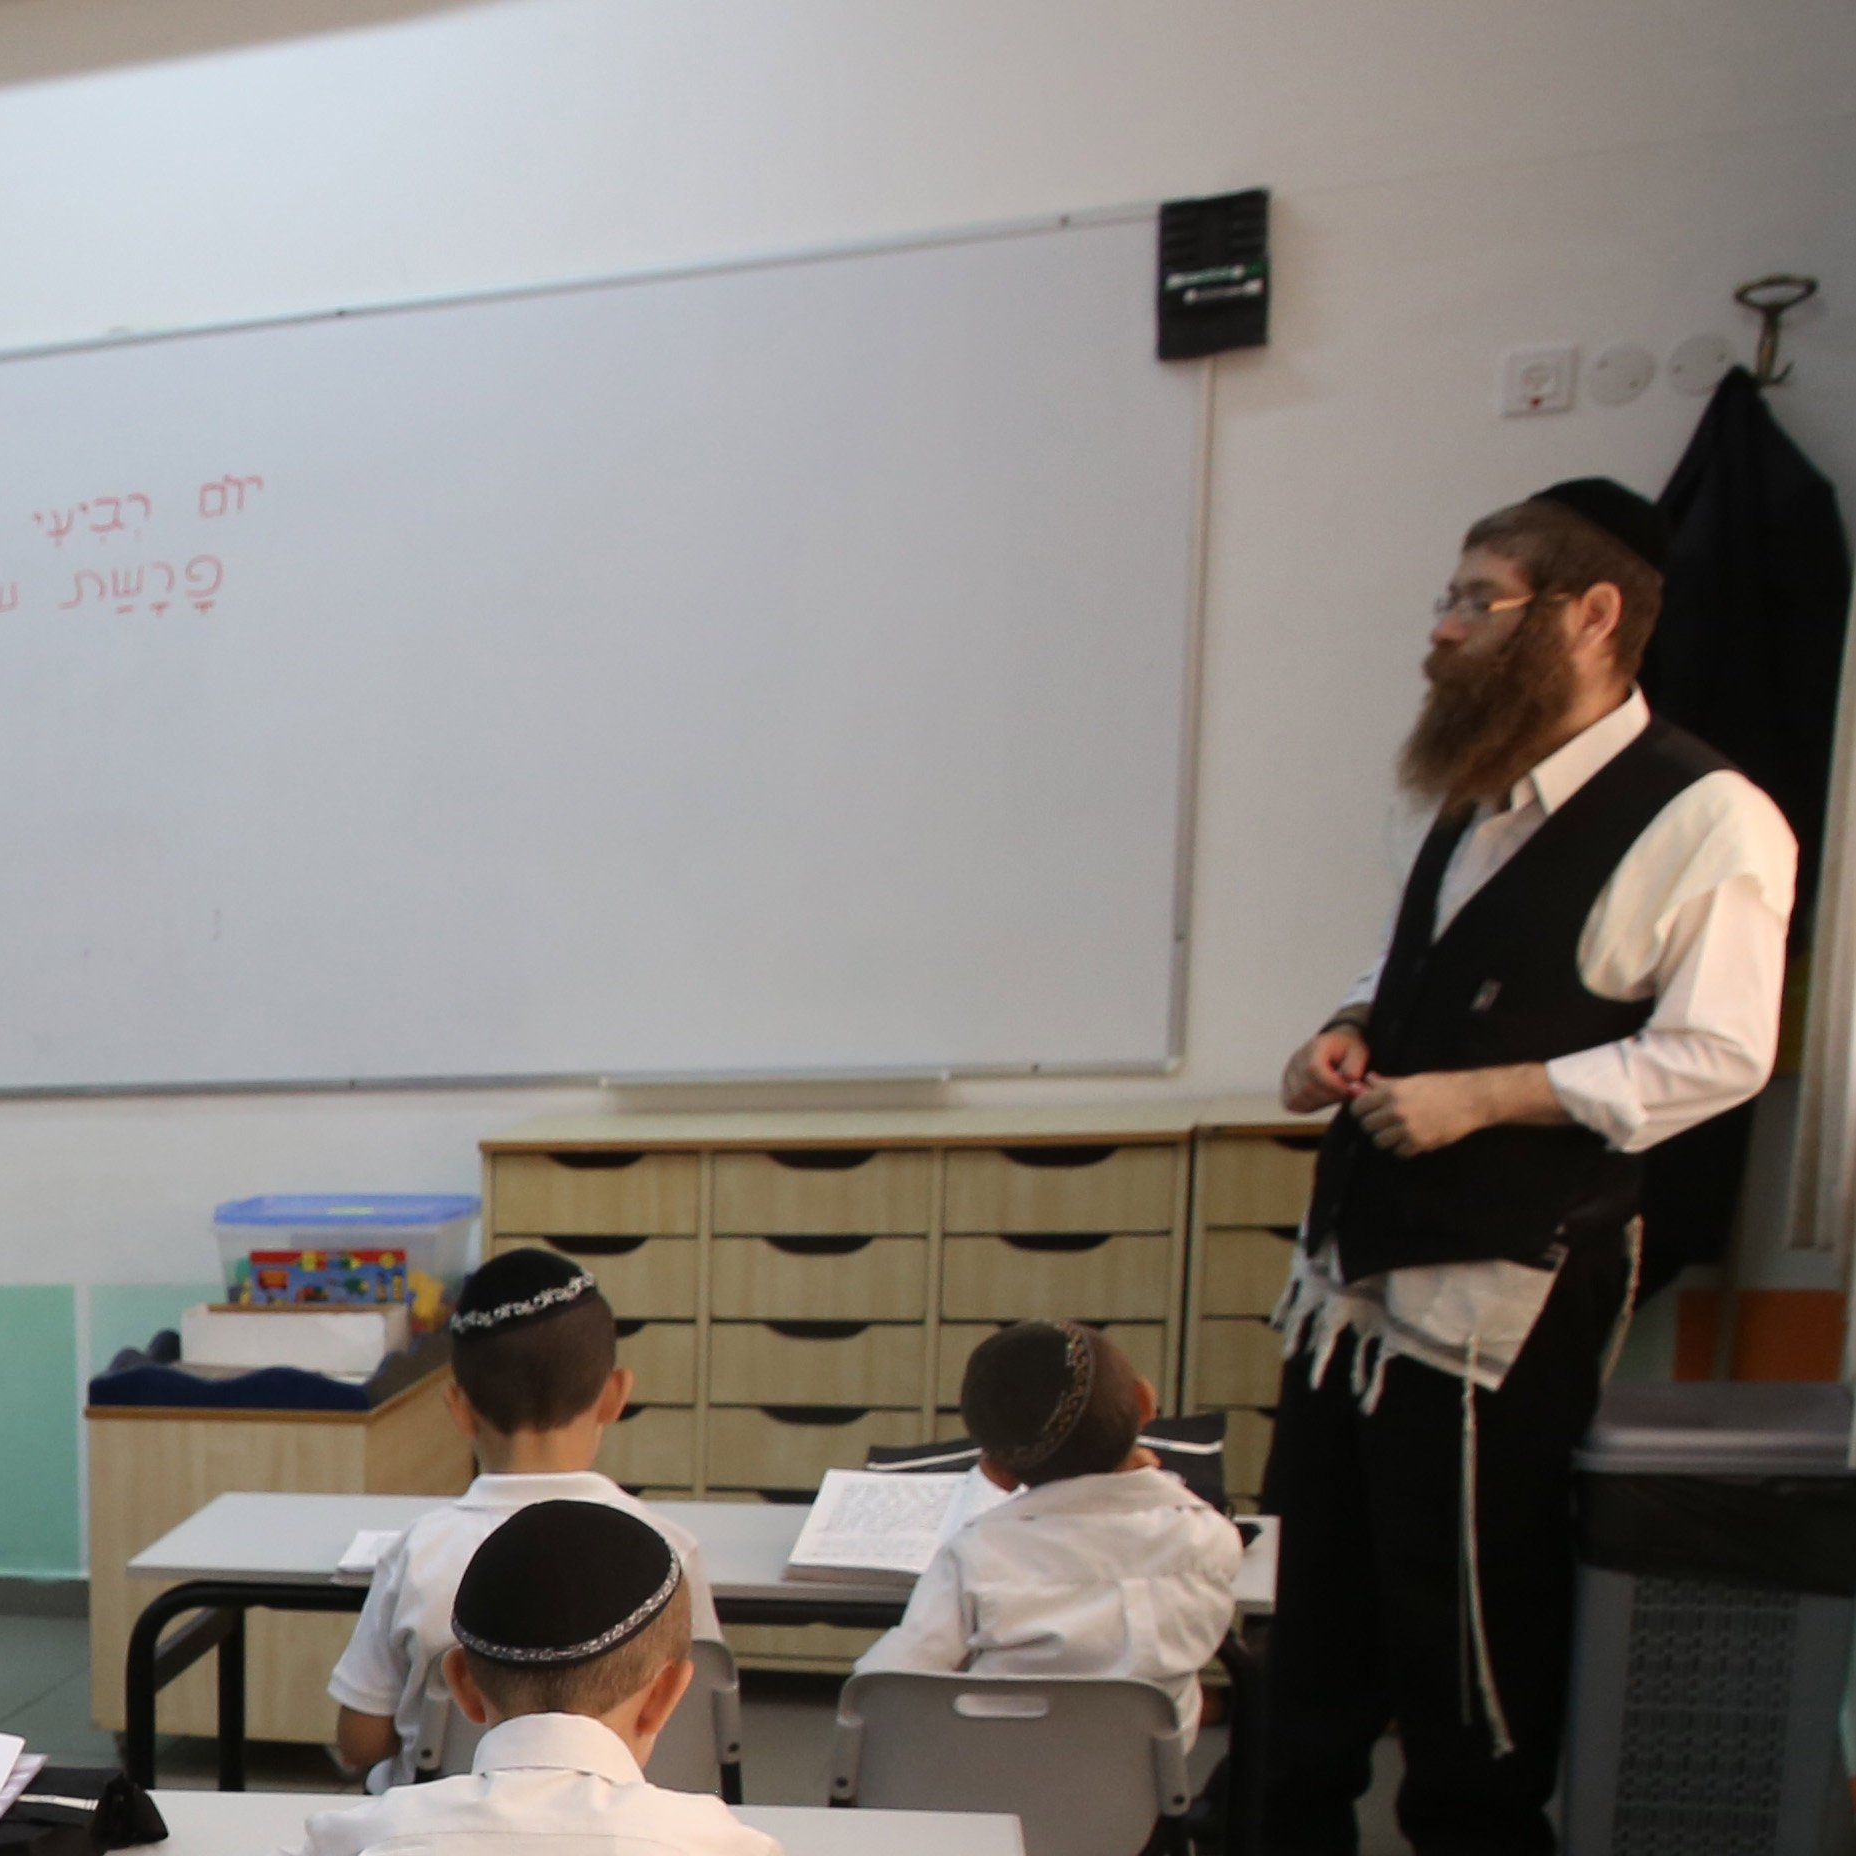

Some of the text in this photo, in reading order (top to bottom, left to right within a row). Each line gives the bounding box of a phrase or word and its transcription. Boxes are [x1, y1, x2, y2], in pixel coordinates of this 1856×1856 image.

[33, 492, 151, 547] רביעי
[197, 473, 263, 520] יום
[59, 554, 224, 616] פרשת
